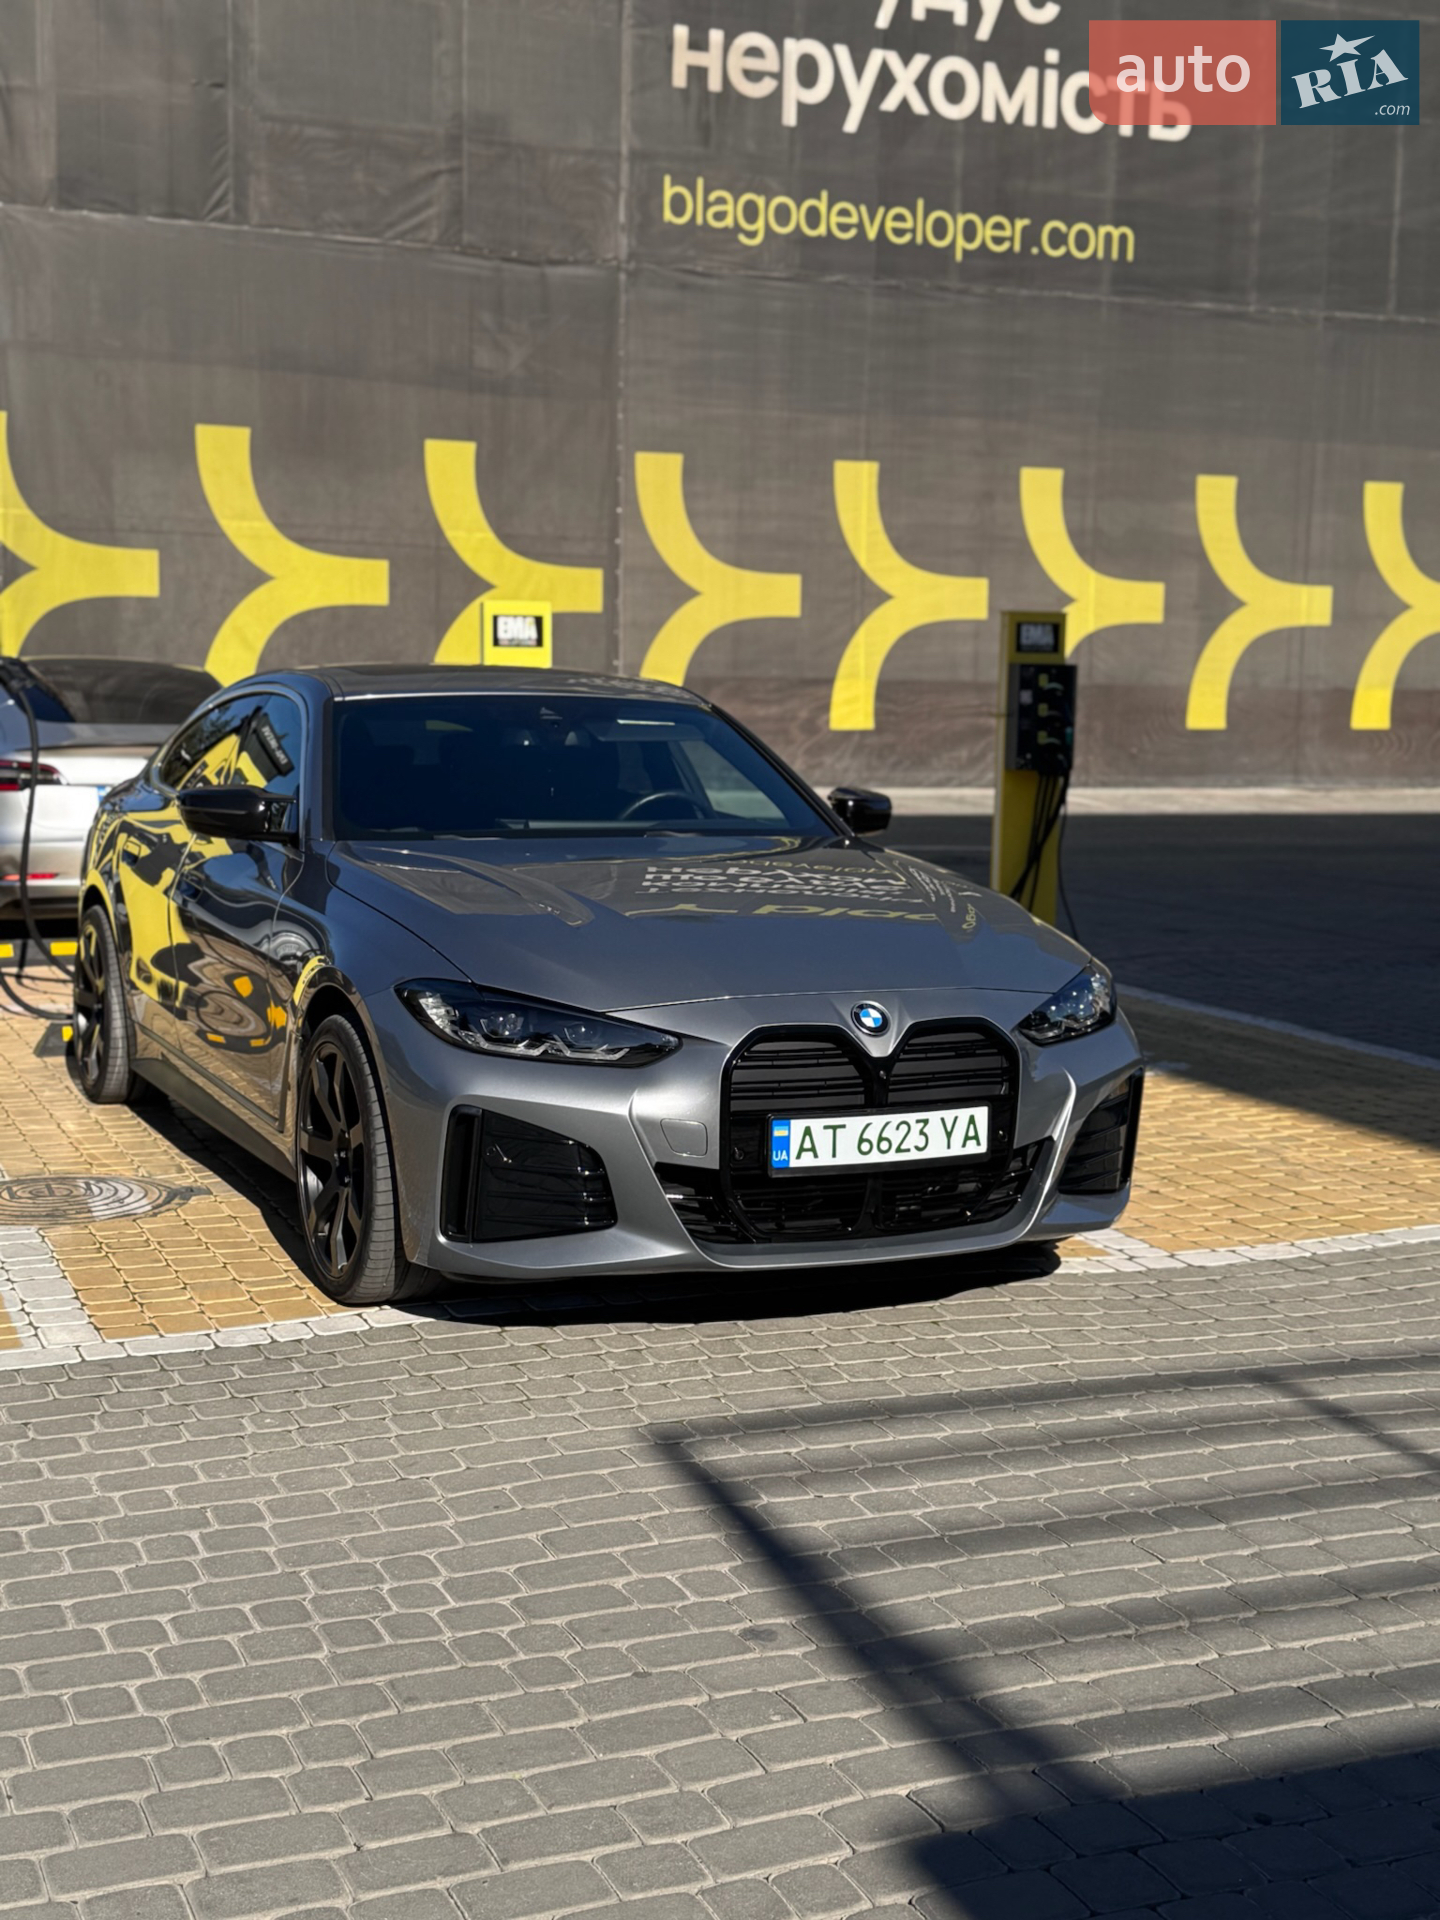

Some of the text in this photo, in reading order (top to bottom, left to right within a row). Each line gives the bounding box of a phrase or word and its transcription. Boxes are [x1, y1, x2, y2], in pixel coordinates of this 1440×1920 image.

[670, 23, 1193, 143] нерухомість
[772, 1149, 788, 1161] UA
[795, 1115, 981, 1160] AT 6623 YA
